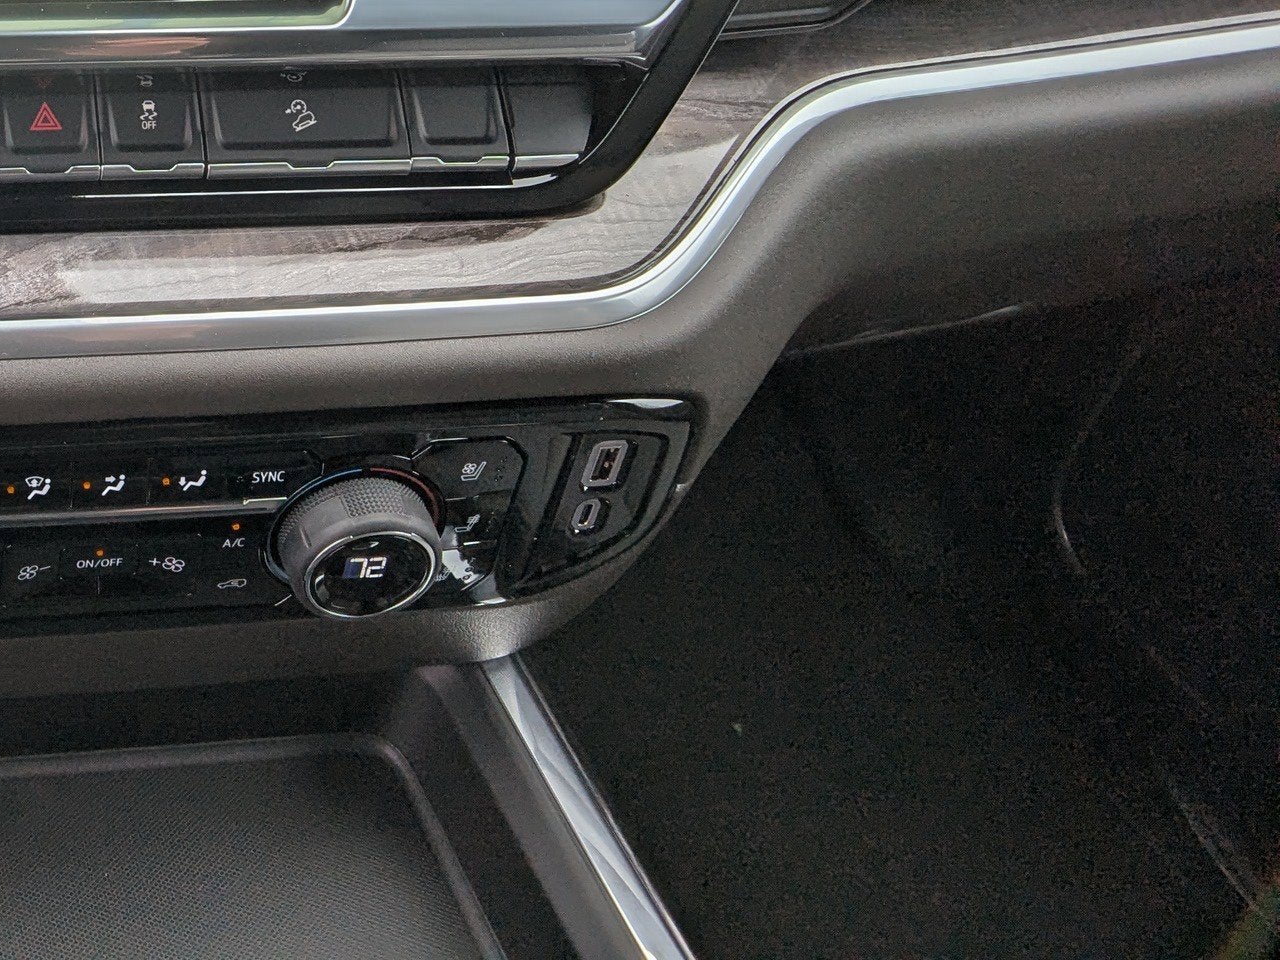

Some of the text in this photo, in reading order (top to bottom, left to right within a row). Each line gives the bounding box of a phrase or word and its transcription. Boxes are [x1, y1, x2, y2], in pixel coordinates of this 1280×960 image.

[141, 120, 157, 130] OFF
[251, 470, 286, 484] SYNC
[222, 538, 246, 548] A/C
[76, 557, 124, 569] ON/OFF
[348, 556, 388, 579] 72
